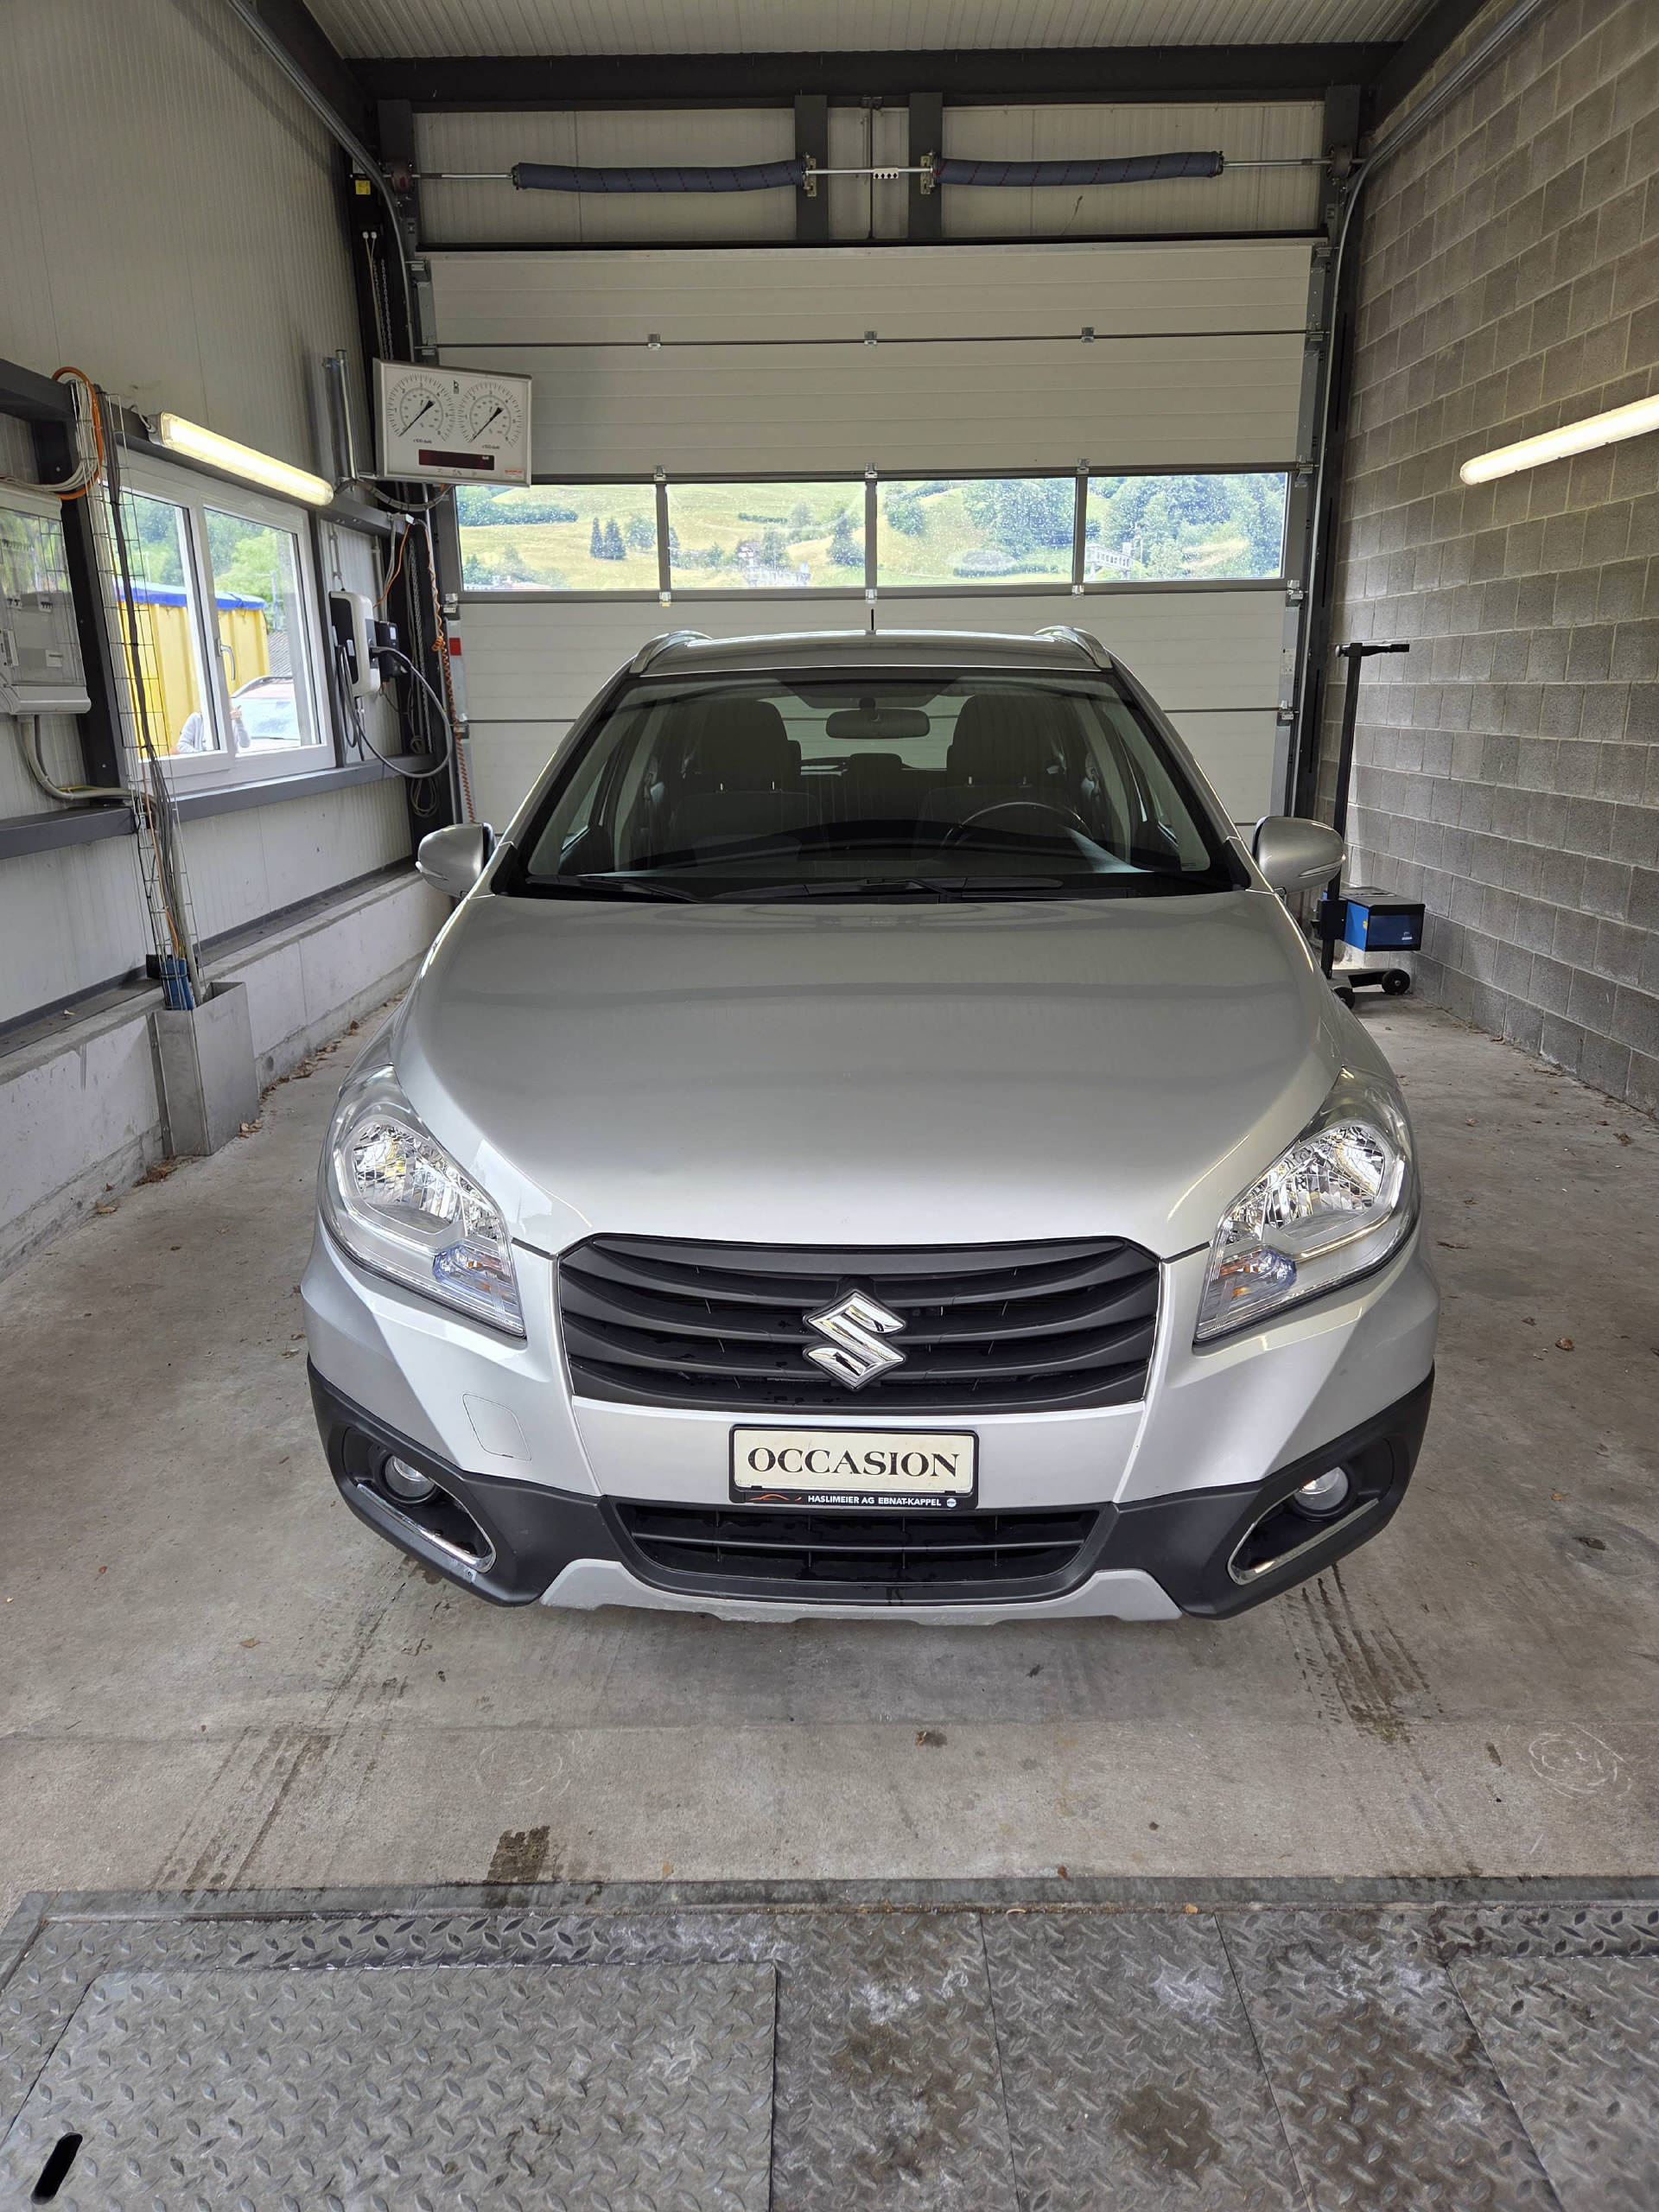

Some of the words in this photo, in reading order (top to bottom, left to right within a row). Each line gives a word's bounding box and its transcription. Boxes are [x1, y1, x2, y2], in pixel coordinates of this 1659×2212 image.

[747, 1447, 961, 1478] OCCASION
[808, 1495, 860, 1504] HASLIMEIER
[878, 1497, 942, 1506] EBNAT-KAPPEL
